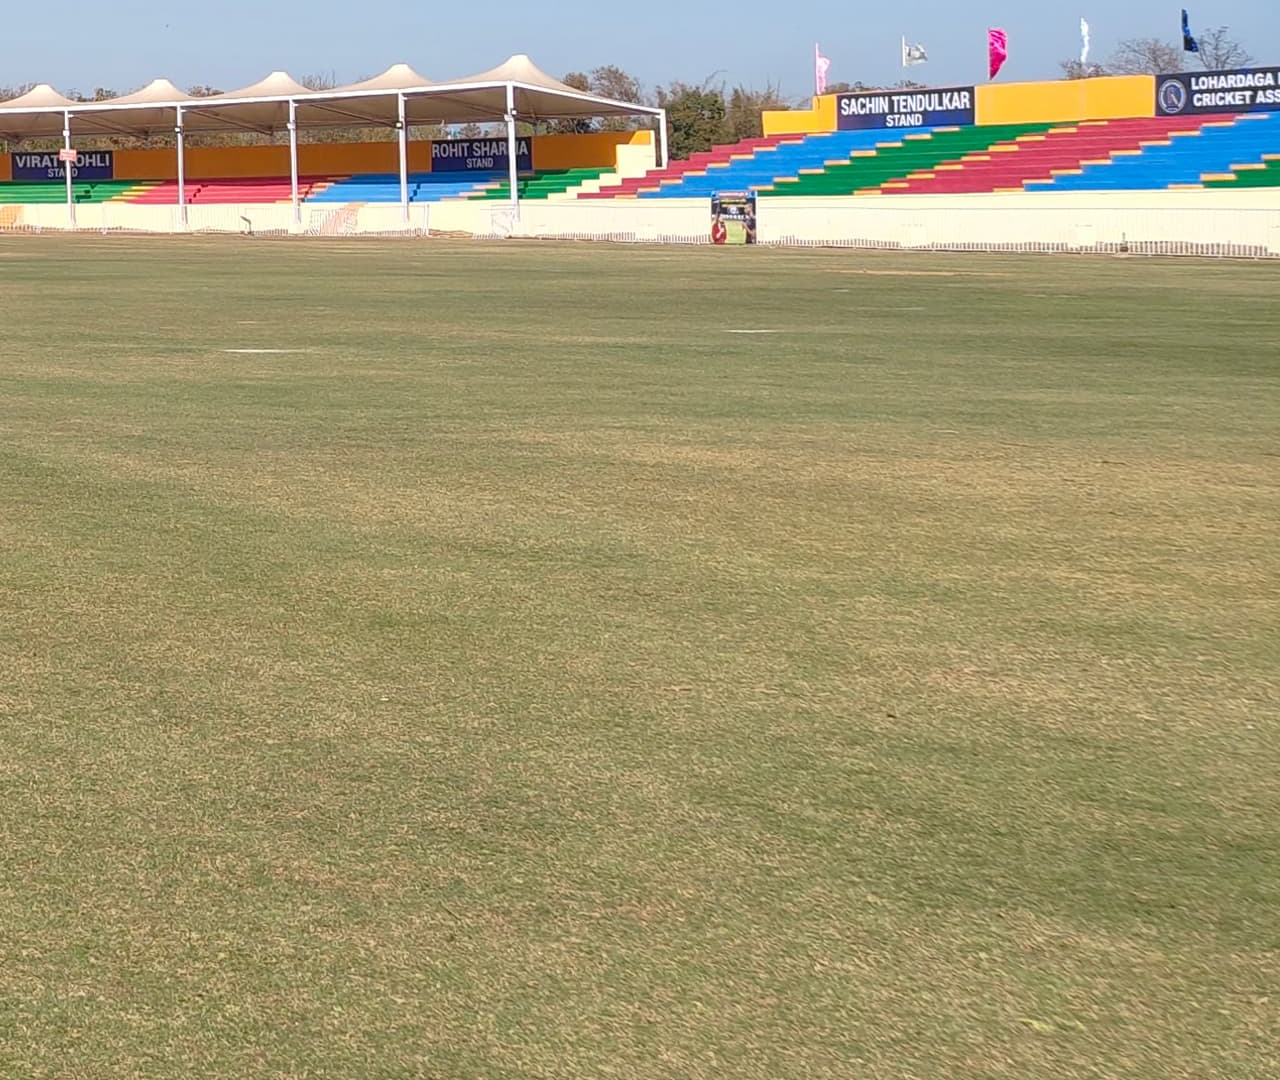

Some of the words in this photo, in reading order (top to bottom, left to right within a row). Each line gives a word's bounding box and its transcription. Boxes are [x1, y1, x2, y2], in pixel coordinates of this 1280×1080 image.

[1191, 72, 1275, 90] LOHARDAGA
[841, 95, 889, 116] SACHIN
[891, 91, 971, 113] TENDULKAR
[1193, 90, 1254, 107] CRICKET
[886, 113, 922, 127] STAND
[432, 142, 470, 158] ROHIT
[472, 140, 528, 157] SHARA
[16, 154, 60, 168] VIRAT
[64, 153, 110, 167] OHLI
[466, 158, 494, 169] STAND
[48, 167, 78, 178] STAD
